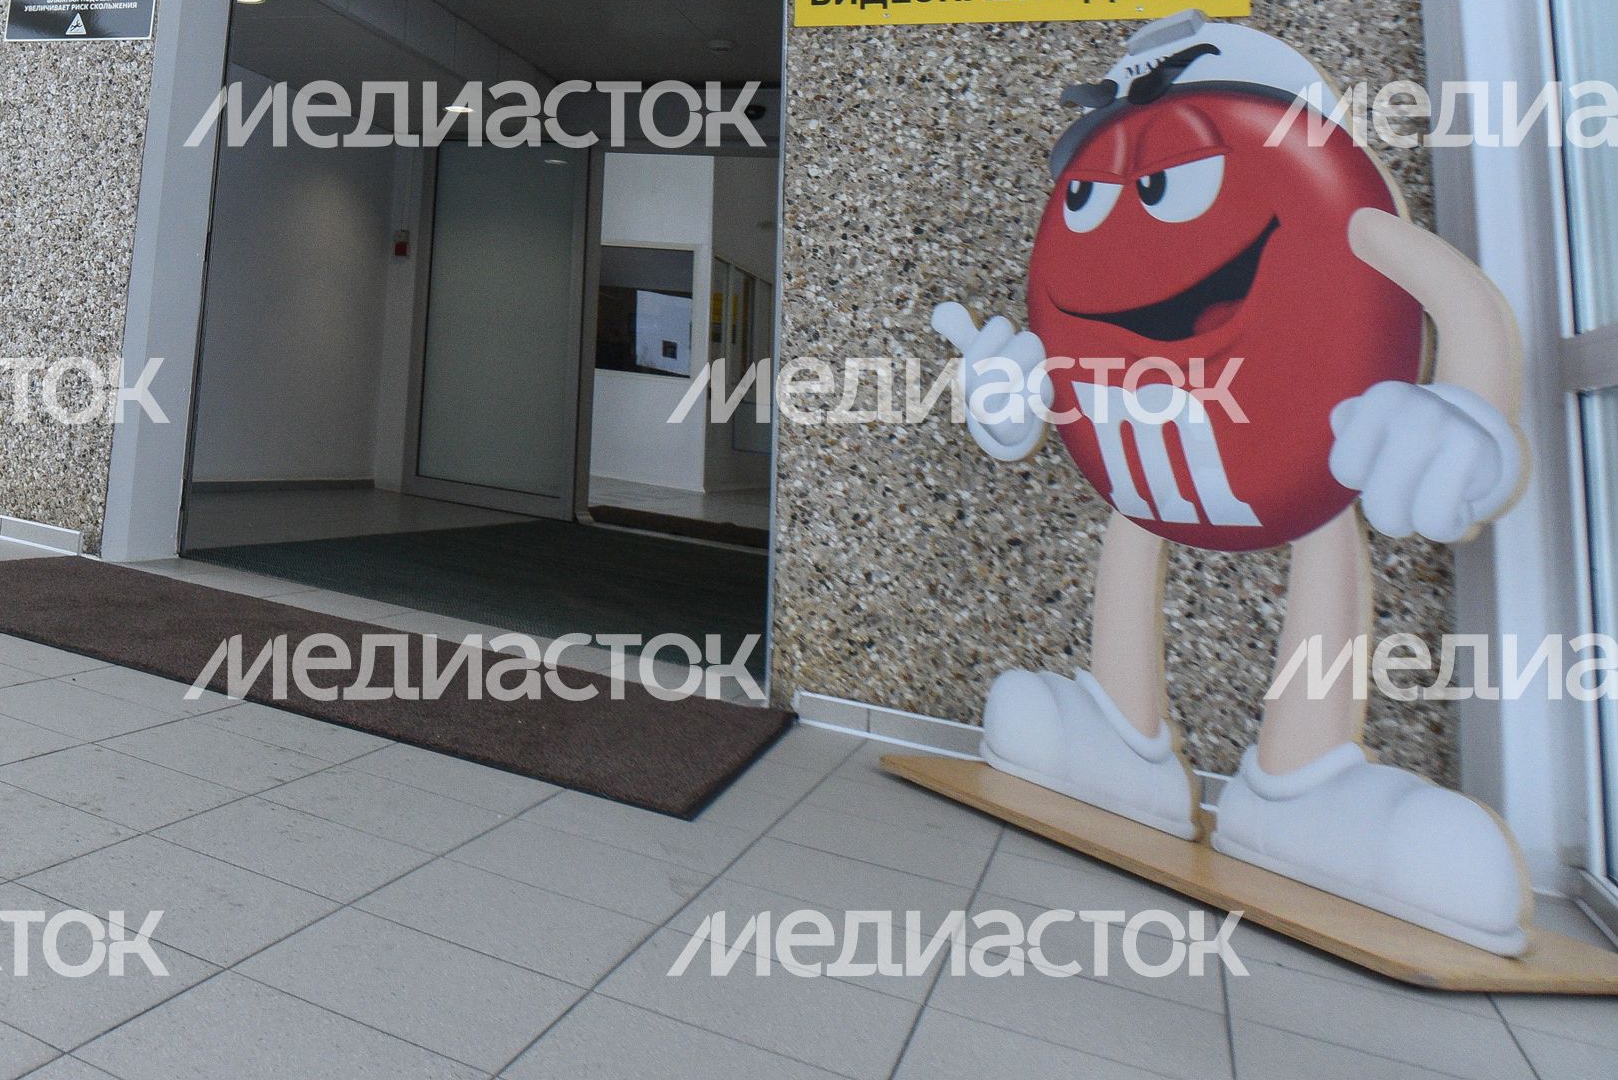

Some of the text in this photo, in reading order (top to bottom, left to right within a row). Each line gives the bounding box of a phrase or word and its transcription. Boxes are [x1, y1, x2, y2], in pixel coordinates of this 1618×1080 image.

[23, 1, 138, 12] УВЕЛИЧИВАЕТ РИСК СКОЛЬЖЕНИЯ
